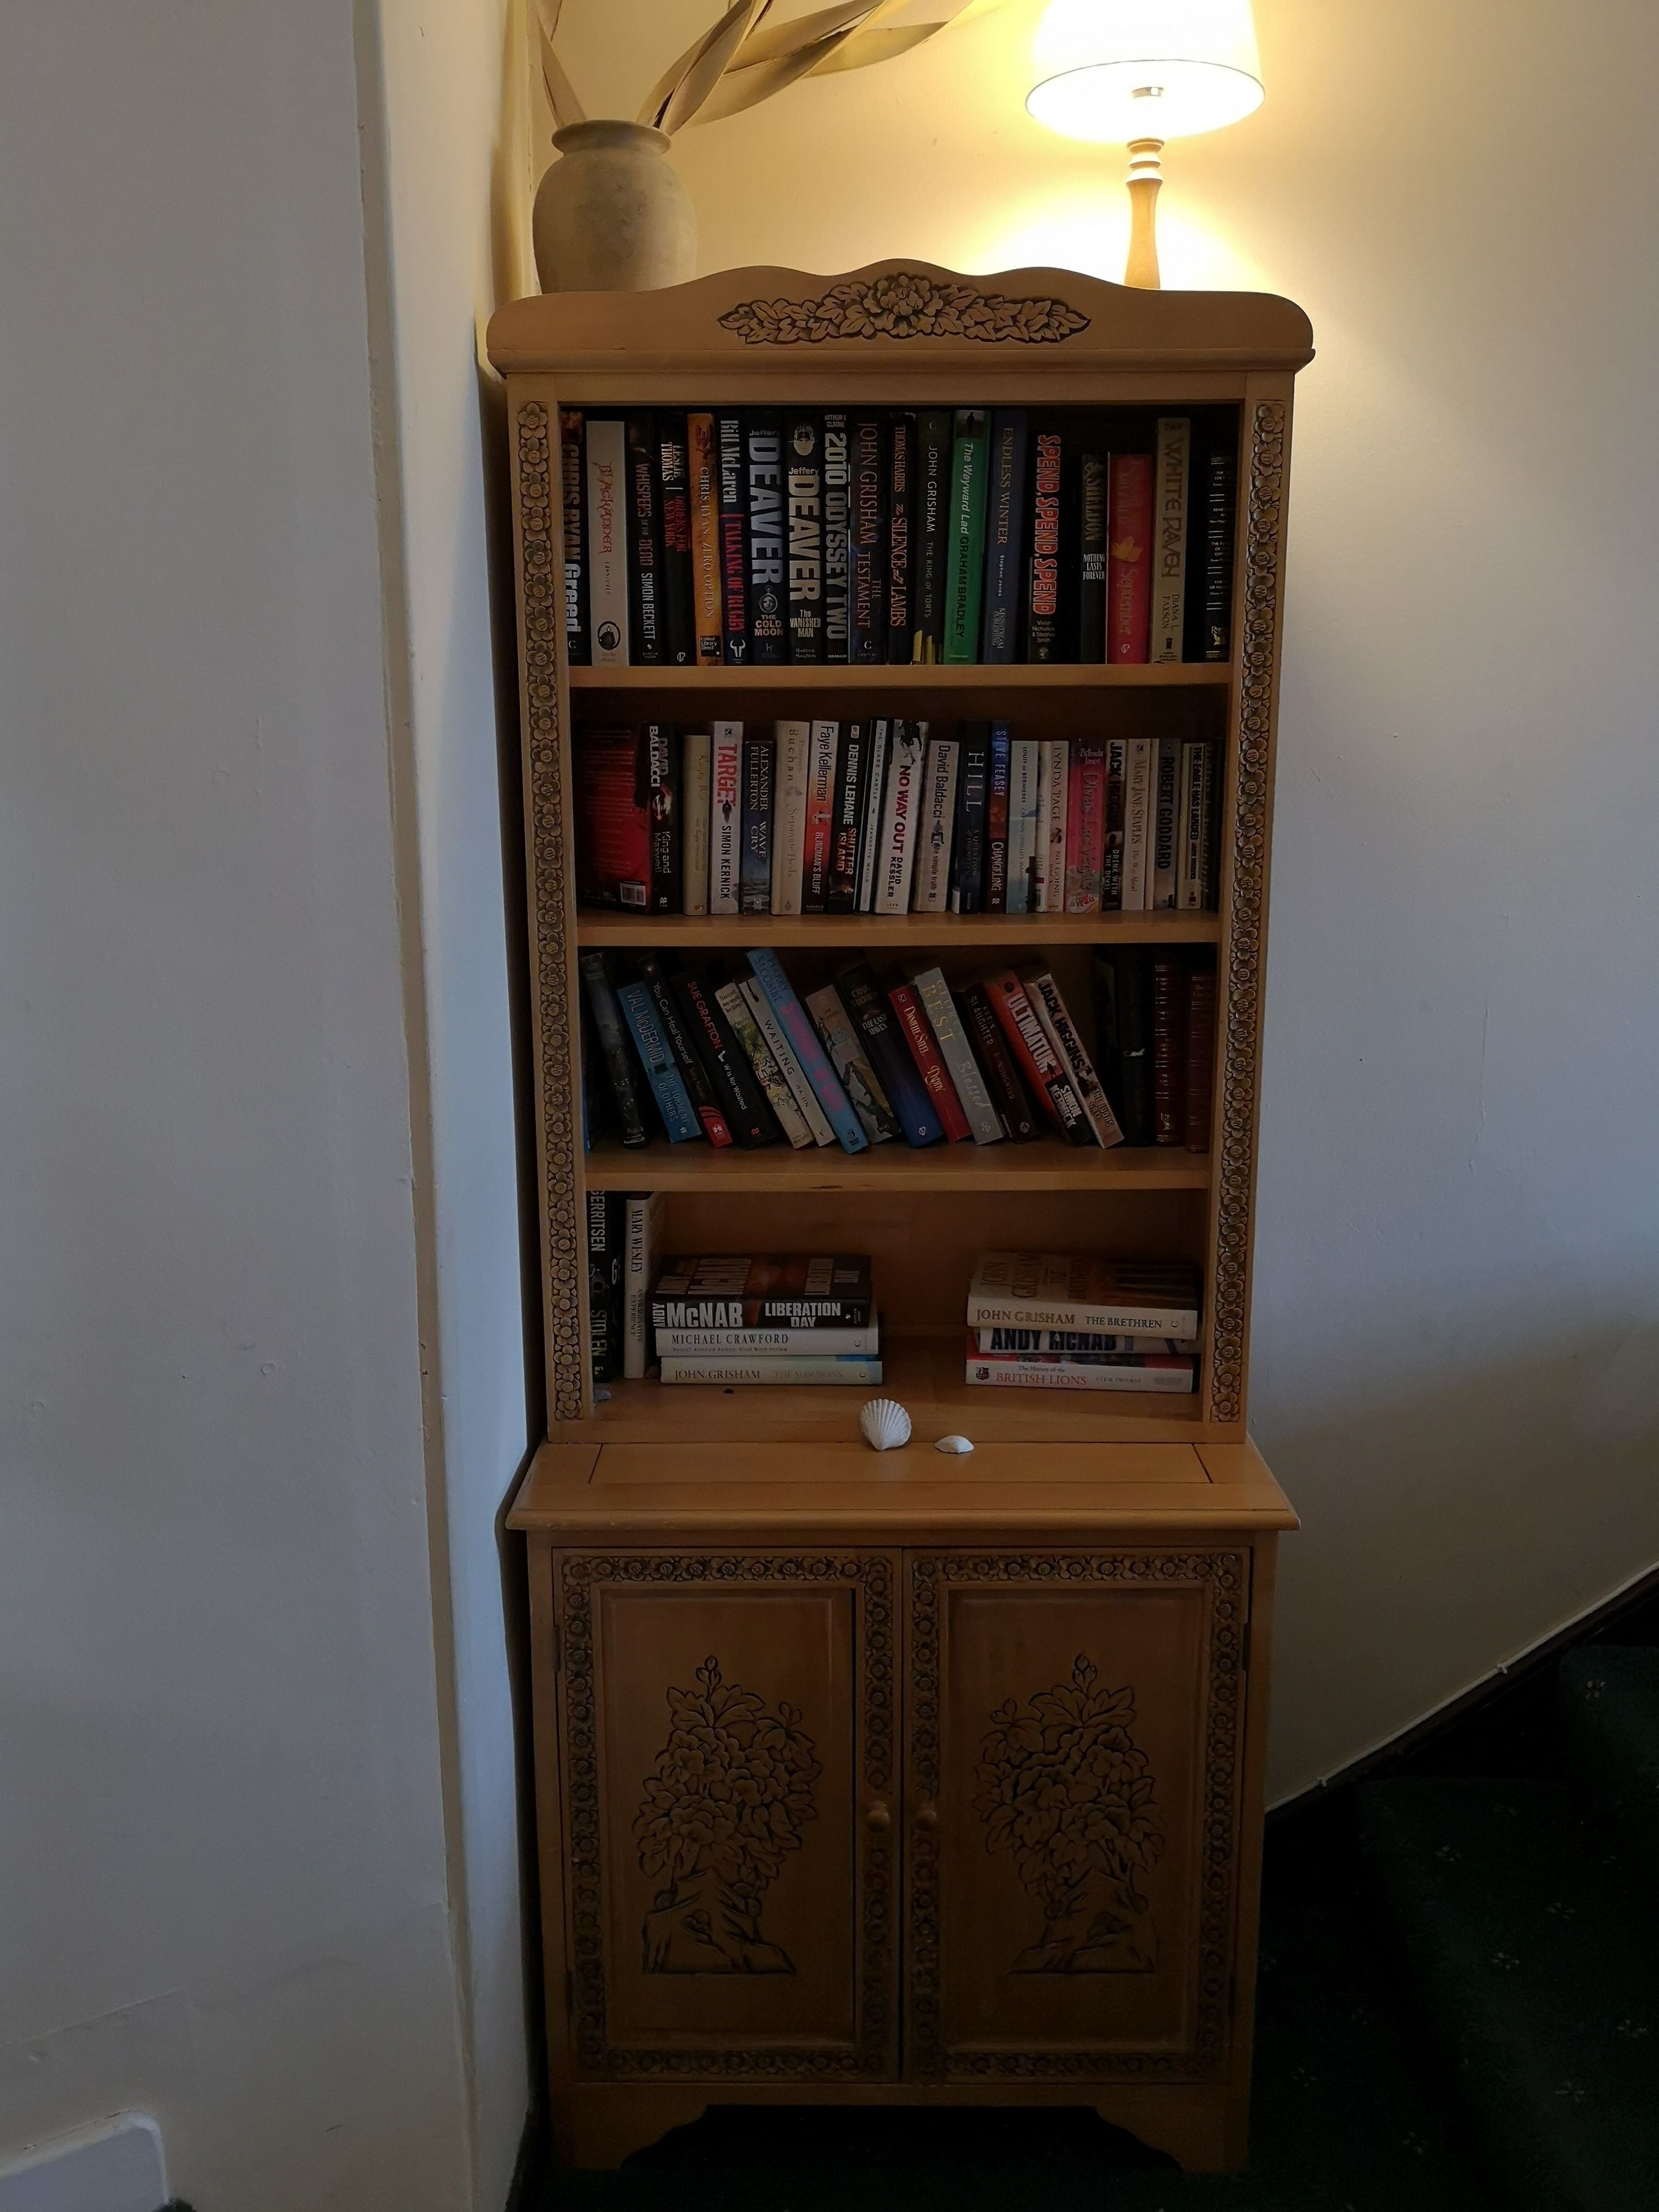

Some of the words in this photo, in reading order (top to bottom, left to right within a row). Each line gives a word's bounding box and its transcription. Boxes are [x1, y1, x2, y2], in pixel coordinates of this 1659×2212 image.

[719, 419, 739, 443] Bill
[857, 423, 877, 466] JOHN
[661, 442, 675, 482] THOMAS
[673, 444, 685, 478] LESLIE
[825, 433, 847, 485] 2010
[927, 445, 937, 476] JOHN
[964, 442, 974, 461] The
[1000, 427, 1014, 488] ENDLESS
[1036, 434, 1061, 496] SPEND,
[699, 467, 710, 501] CHRIS
[721, 446, 741, 503] McLaren
[788, 467, 819, 476] Jeffery
[960, 464, 972, 511] Wayward
[1163, 438, 1182, 512] WHITE
[700, 505, 710, 535] RYAN
[749, 437, 783, 585] DEAVER
[858, 471, 878, 544] GRISHAM
[926, 481, 937, 532] GRISHAM
[997, 492, 1010, 544] WINTER
[1085, 478, 1103, 541] SHELDON
[789, 475, 821, 601] DEAVER
[825, 492, 847, 588] ODYSSEY
[960, 514, 970, 534] Lad
[1033, 497, 1059, 557] SPEND,
[702, 542, 711, 570] ZERO
[725, 520, 744, 574] TALKING
[958, 536, 969, 584] GRAHAM
[1083, 554, 1105, 562] NOTHING
[1161, 517, 1181, 578] RAVEN
[925, 560, 933, 579] KING
[1083, 571, 1105, 580] FOREVER
[1087, 562, 1103, 571] LASTS
[641, 572, 655, 601] SIMON
[703, 574, 714, 619] OPTION
[727, 577, 744, 592] OF
[857, 551, 871, 628] TESTAMENT
[871, 578, 881, 599] THE
[925, 581, 932, 590] OF
[1032, 558, 1058, 615] SPEND
[642, 603, 656, 640] BECKETT
[728, 594, 745, 634] RUGBY
[790, 618, 821, 628] VANISHED
[800, 609, 812, 618] The
[826, 593, 848, 639] TWO
[924, 594, 932, 618] TORTS
[955, 586, 967, 638] BRADLEY
[1162, 595, 1171, 629] PAXSON
[1172, 593, 1180, 620] DIANA
[754, 628, 783, 637] MOON
[755, 619, 782, 628] COLD
[797, 627, 814, 638] MAN
[819, 726, 834, 750] Faye
[995, 730, 1007, 757] STEVE
[1080, 747, 1103, 757] Belinda
[1192, 747, 1202, 761] THE
[649, 725, 661, 787] BALDACCI
[658, 737, 669, 776] DAVID
[787, 729, 798, 782] Buchan
[846, 744, 859, 783] DENNIS
[937, 745, 950, 772] David
[1052, 747, 1062, 787] LYNDA
[1109, 742, 1122, 777] JACK
[717, 744, 737, 808] TARGET
[749, 746, 759, 810] FULLERTON
[759, 745, 770, 812] ALEXANDER
[816, 752, 832, 802] Kellerman
[899, 764, 911, 787] NO
[965, 751, 984, 813] HILL
[993, 764, 1005, 796] FEASEY
[1160, 756, 1175, 805] ROBERT
[1192, 764, 1202, 789] EAGLE
[843, 785, 856, 825] LEHANE
[896, 790, 909, 821] WAY
[933, 776, 949, 819] Baldacci
[1052, 790, 1061, 821] PAGE
[1191, 790, 1200, 806] HAS
[721, 825, 731, 855] SIMON
[751, 825, 759, 853] CRY
[758, 821, 766, 858] WAVE
[892, 822, 906, 854] OUT
[1157, 808, 1173, 869] GODDARD
[1190, 808, 1199, 840] LANDED
[653, 832, 662, 873] Maxwell
[660, 831, 671, 853] King
[812, 832, 824, 872] BLINDMAN'S
[835, 832, 847, 872] ISLAND
[846, 827, 857, 875] SHUTTER
[1055, 851, 1061, 864] NO
[662, 854, 671, 874] and
[887, 857, 897, 898] KESSLER
[895, 857, 904, 885] DAVID
[930, 855, 939, 875] simple
[1111, 849, 1120, 873] DRINK
[720, 858, 730, 899] KERNICK
[811, 873, 823, 895] BLUFF
[930, 876, 938, 891] truth
[1110, 876, 1119, 895] WITH
[627, 990, 645, 1012] VAL
[687, 981, 703, 1001] SUE
[696, 999, 724, 1050] GRAFTON
[923, 984, 955, 1040] BEST
[633, 1010, 665, 1063] McDERMID
[652, 982, 662, 999] You
[659, 999, 670, 1016] Can
[666, 1016, 678, 1035] Heal
[673, 1033, 694, 1066] Yourself
[969, 995, 994, 1046] SLAUGHTER
[1007, 992, 1057, 1074] ULTIMATUM
[1039, 981, 1062, 1018] JACK
[1054, 1016, 1085, 1071] HIGGINS
[764, 1020, 794, 1075] WAITING
[958, 1060, 991, 1110] Blessed
[1060, 1084, 1082, 1117] SIMON
[1049, 1084, 1077, 1129] KERNICK
[589, 1190, 606, 1252] GERRITSEN
[631, 1210, 643, 1234] MARY
[631, 1238, 643, 1274] WESLEY
[652, 1302, 666, 1328] ANDY
[666, 1302, 743, 1328] McNAB
[764, 1302, 841, 1317] LIBERATION
[790, 1316, 816, 1328] DAY
[977, 1309, 1012, 1321] JOHN
[1014, 1311, 1075, 1324] GRISHAM
[1085, 1316, 1105, 1325] THE
[1107, 1317, 1162, 1328] BRETHREN
[590, 1308, 607, 1357] STOLEN
[672, 1334, 721, 1344] MICHAEL
[726, 1334, 789, 1344] CRAWFORD
[991, 1327, 1042, 1350] ANDY
[675, 1370, 704, 1380] JOHN
[709, 1370, 760, 1379] GRISHAM
[997, 1373, 1044, 1384] BRITISH
[1050, 1375, 1087, 1385] LIONS
